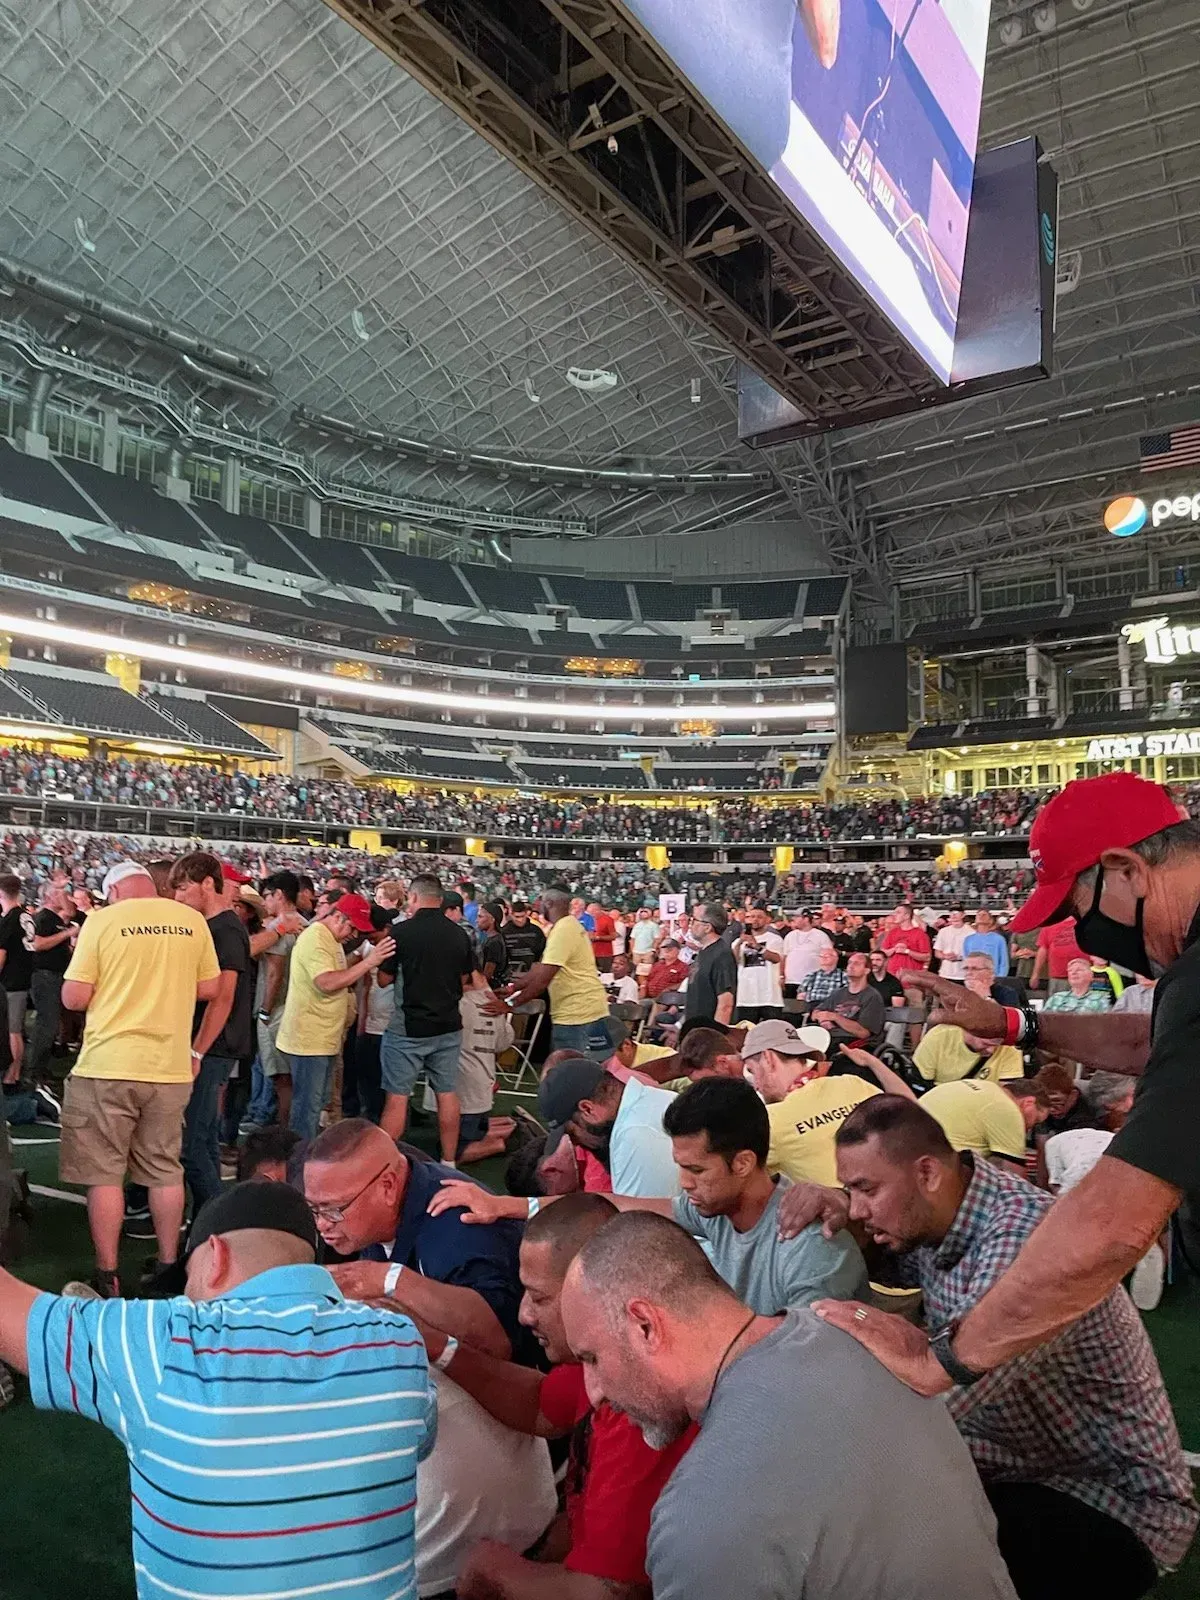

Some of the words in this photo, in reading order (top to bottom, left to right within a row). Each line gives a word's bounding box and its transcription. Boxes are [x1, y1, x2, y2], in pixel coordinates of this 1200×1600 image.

[1087, 736, 1144, 761] AT&T
[667, 900, 678, 914] B
[121, 925, 193, 937] EVANGELISM
